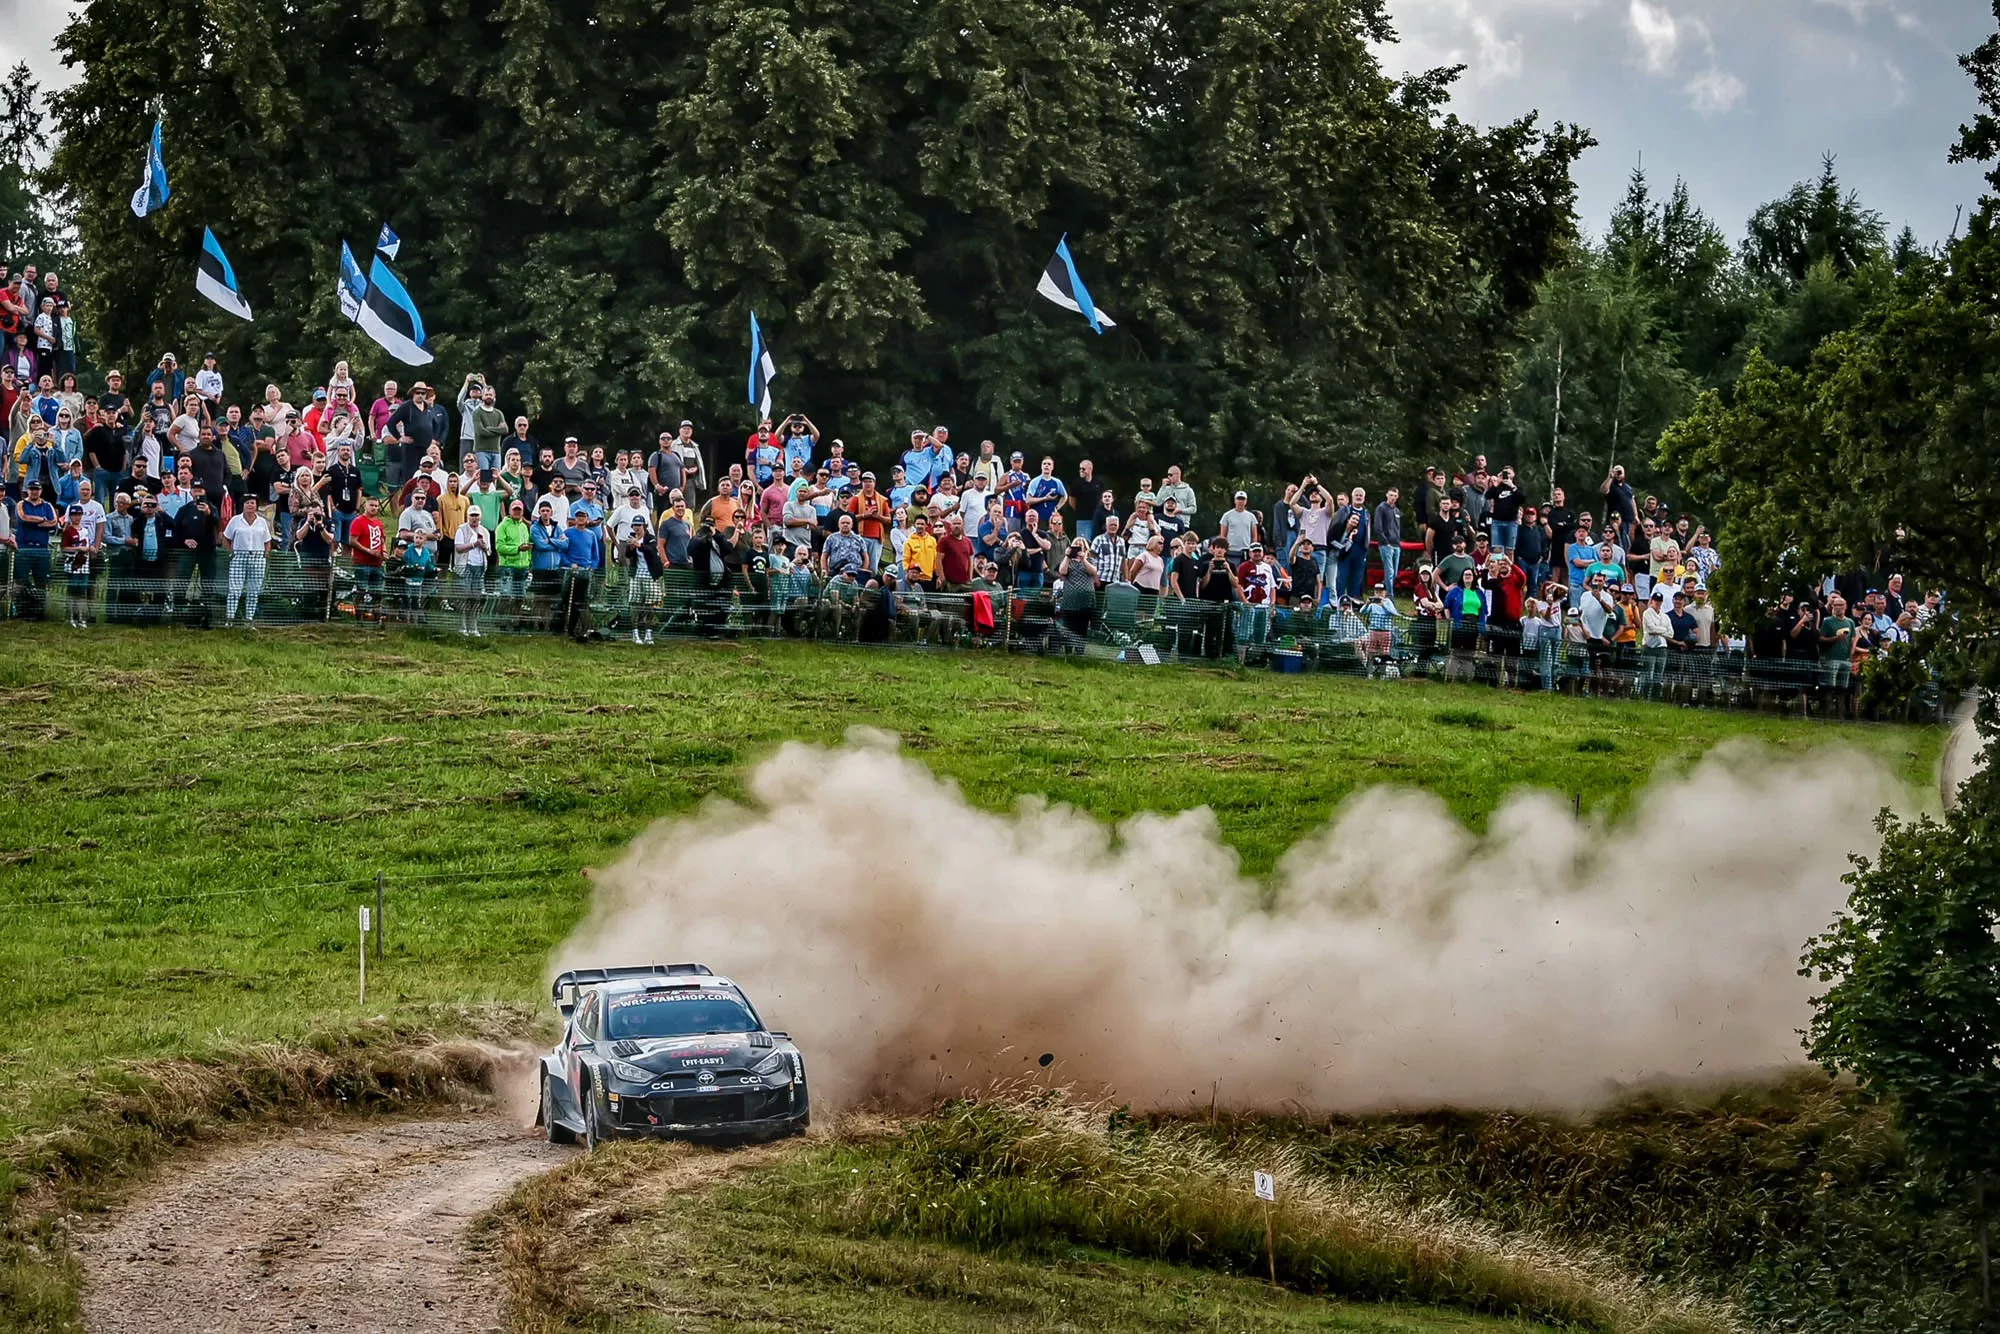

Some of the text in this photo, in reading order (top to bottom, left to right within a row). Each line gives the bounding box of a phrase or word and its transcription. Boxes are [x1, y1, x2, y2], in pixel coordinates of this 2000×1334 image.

[620, 994, 733, 1008] WRC-FANSHOP.COM
[740, 1076, 763, 1084] CCI
[651, 1081, 674, 1090] CCI
